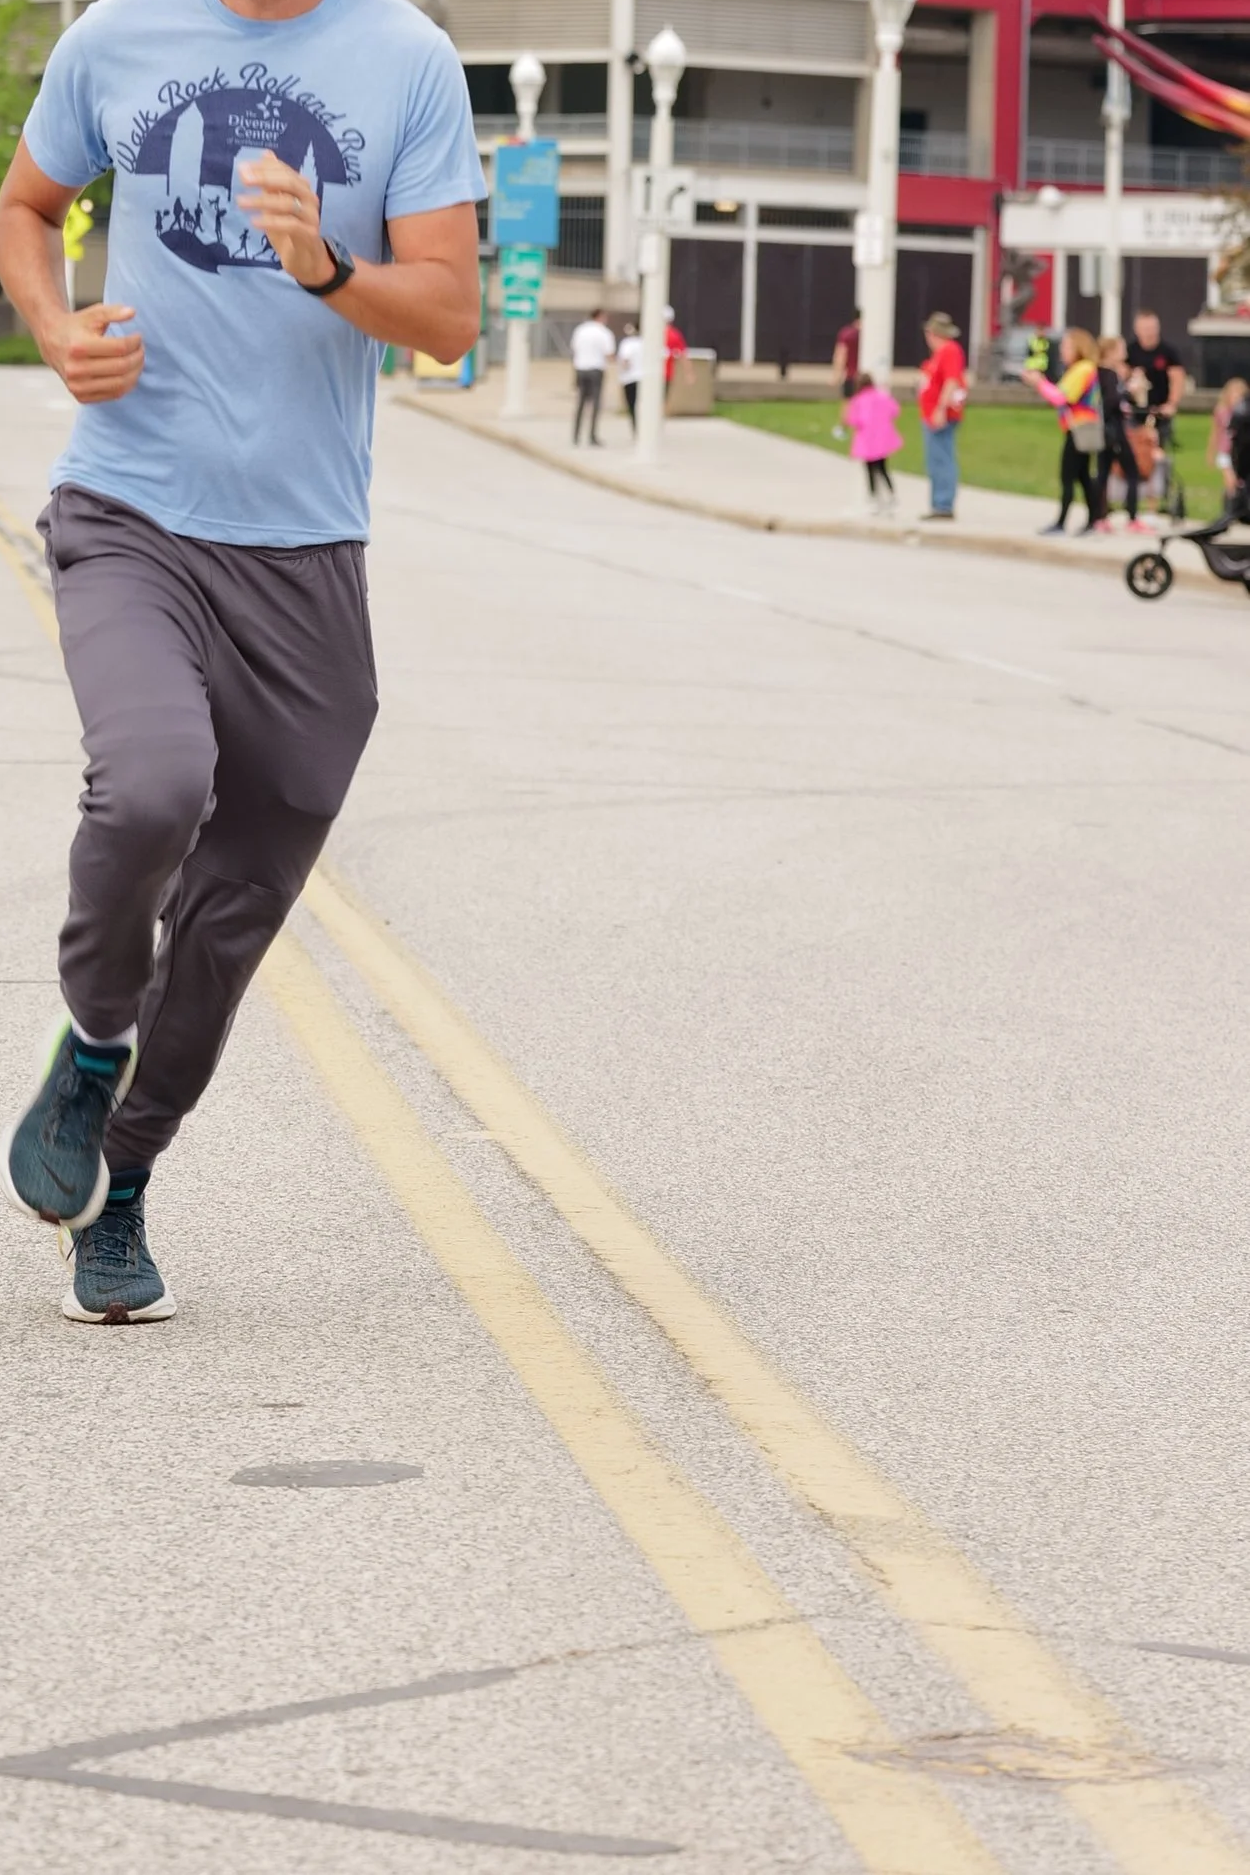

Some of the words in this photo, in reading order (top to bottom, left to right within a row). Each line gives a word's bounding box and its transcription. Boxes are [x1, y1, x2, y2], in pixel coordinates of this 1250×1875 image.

[117, 109, 158, 174] Walk
[158, 67, 230, 109] Rock
[239, 62, 300, 97] Roll
[296, 91, 347, 128] and
[336, 128, 366, 188] Run
[228, 113, 288, 135] Diversity
[234, 125, 280, 141] Center
